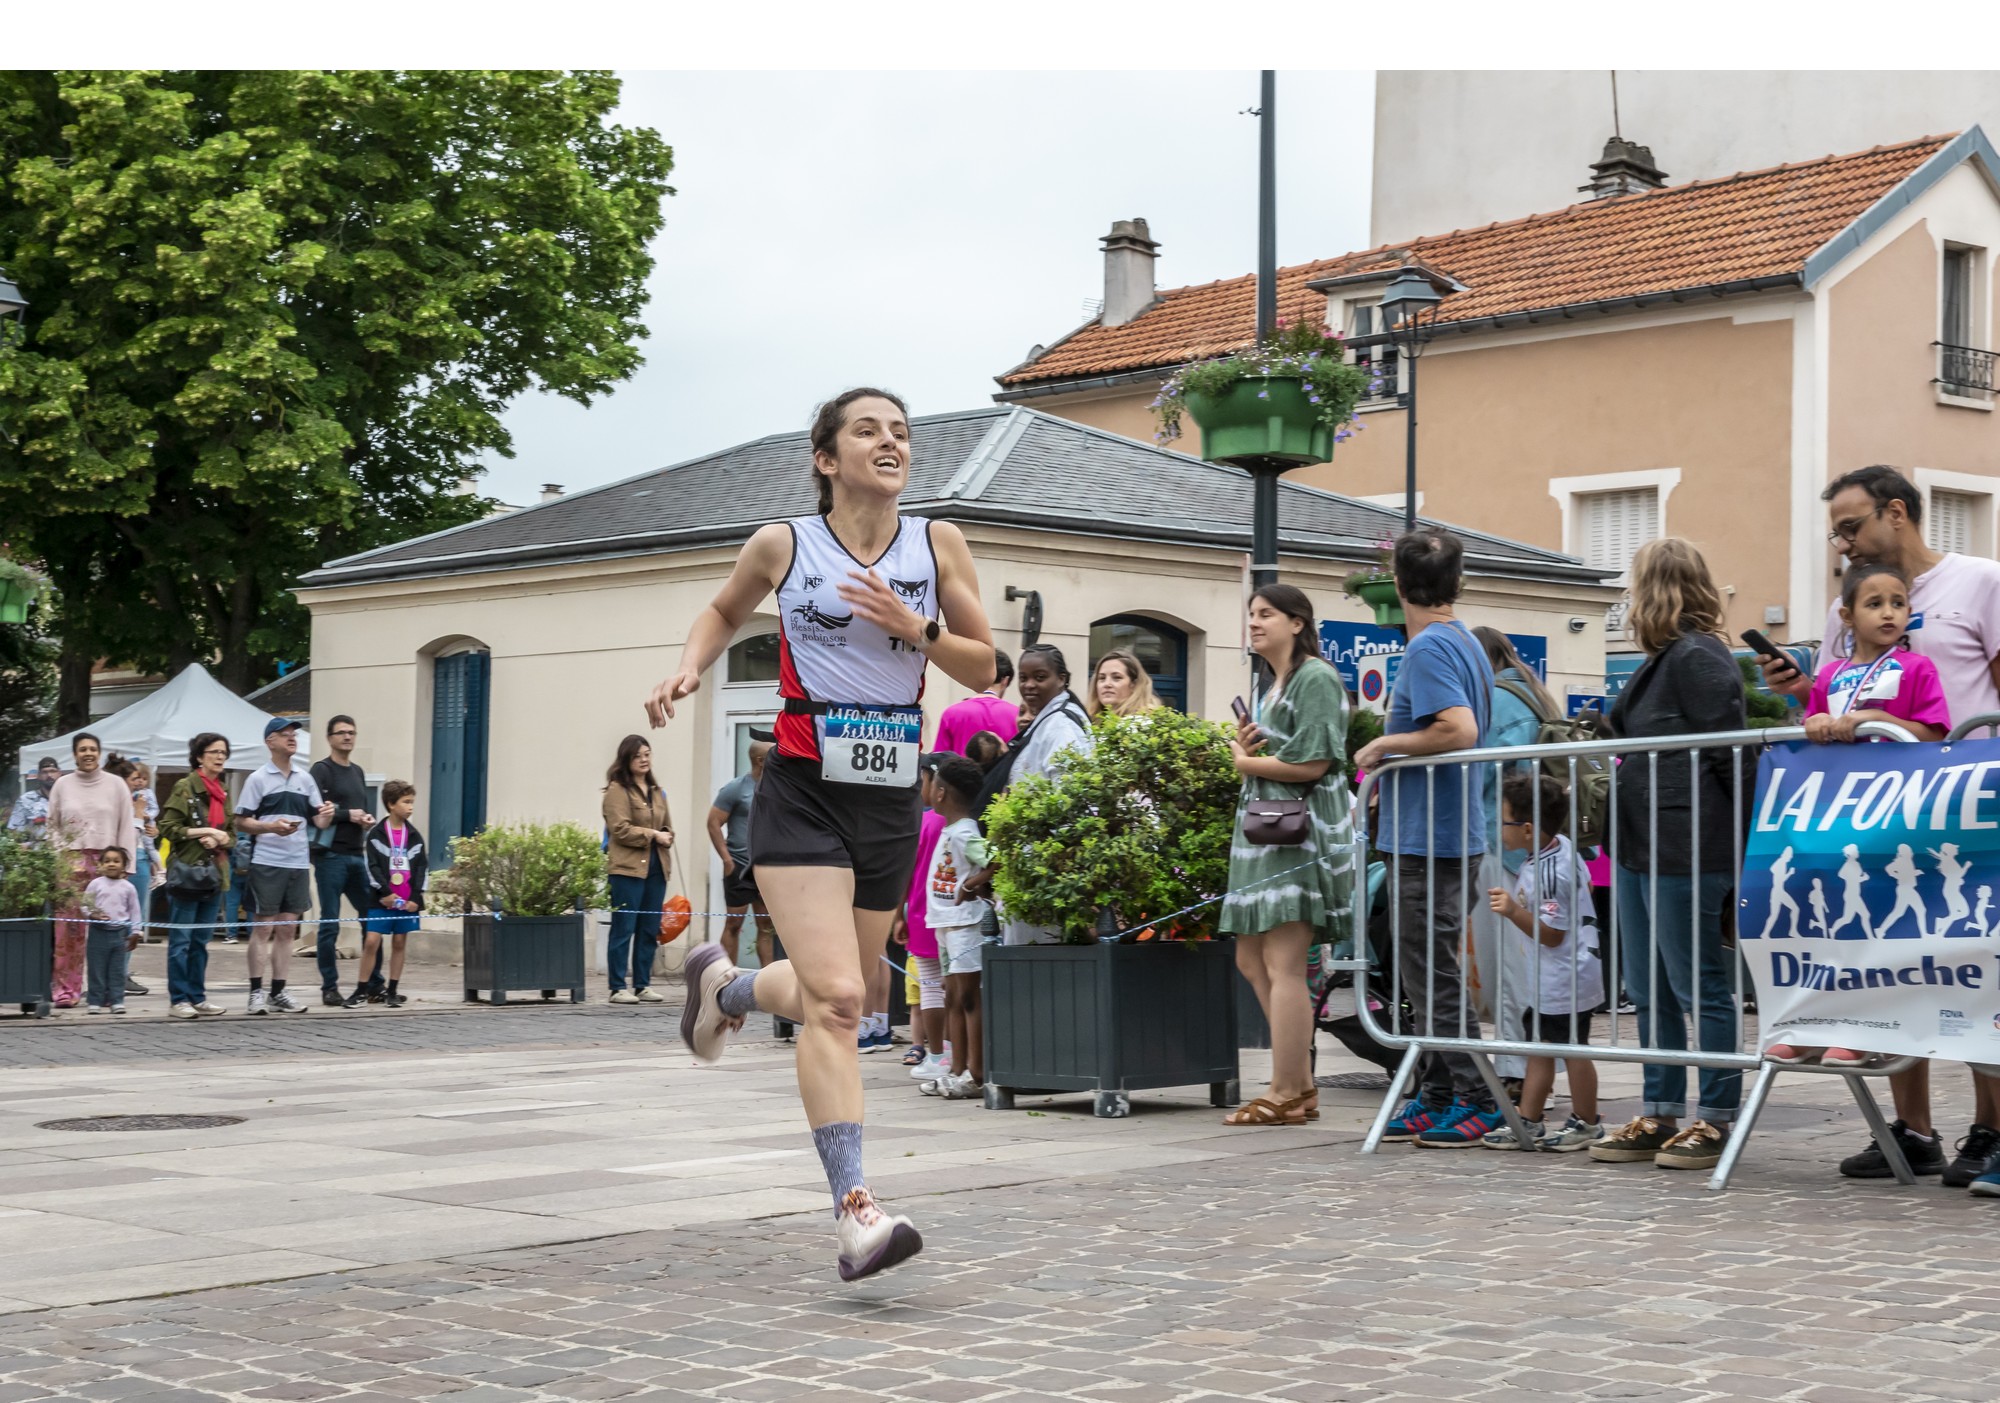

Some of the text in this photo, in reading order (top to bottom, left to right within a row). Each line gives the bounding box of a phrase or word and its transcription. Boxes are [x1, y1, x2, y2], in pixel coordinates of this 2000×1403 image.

[802, 632, 847, 643] Robinson
[851, 743, 898, 773] 884
[865, 775, 887, 783] ALEXIA
[1756, 768, 1825, 832] LA
[1770, 951, 1983, 991] Dimanche
